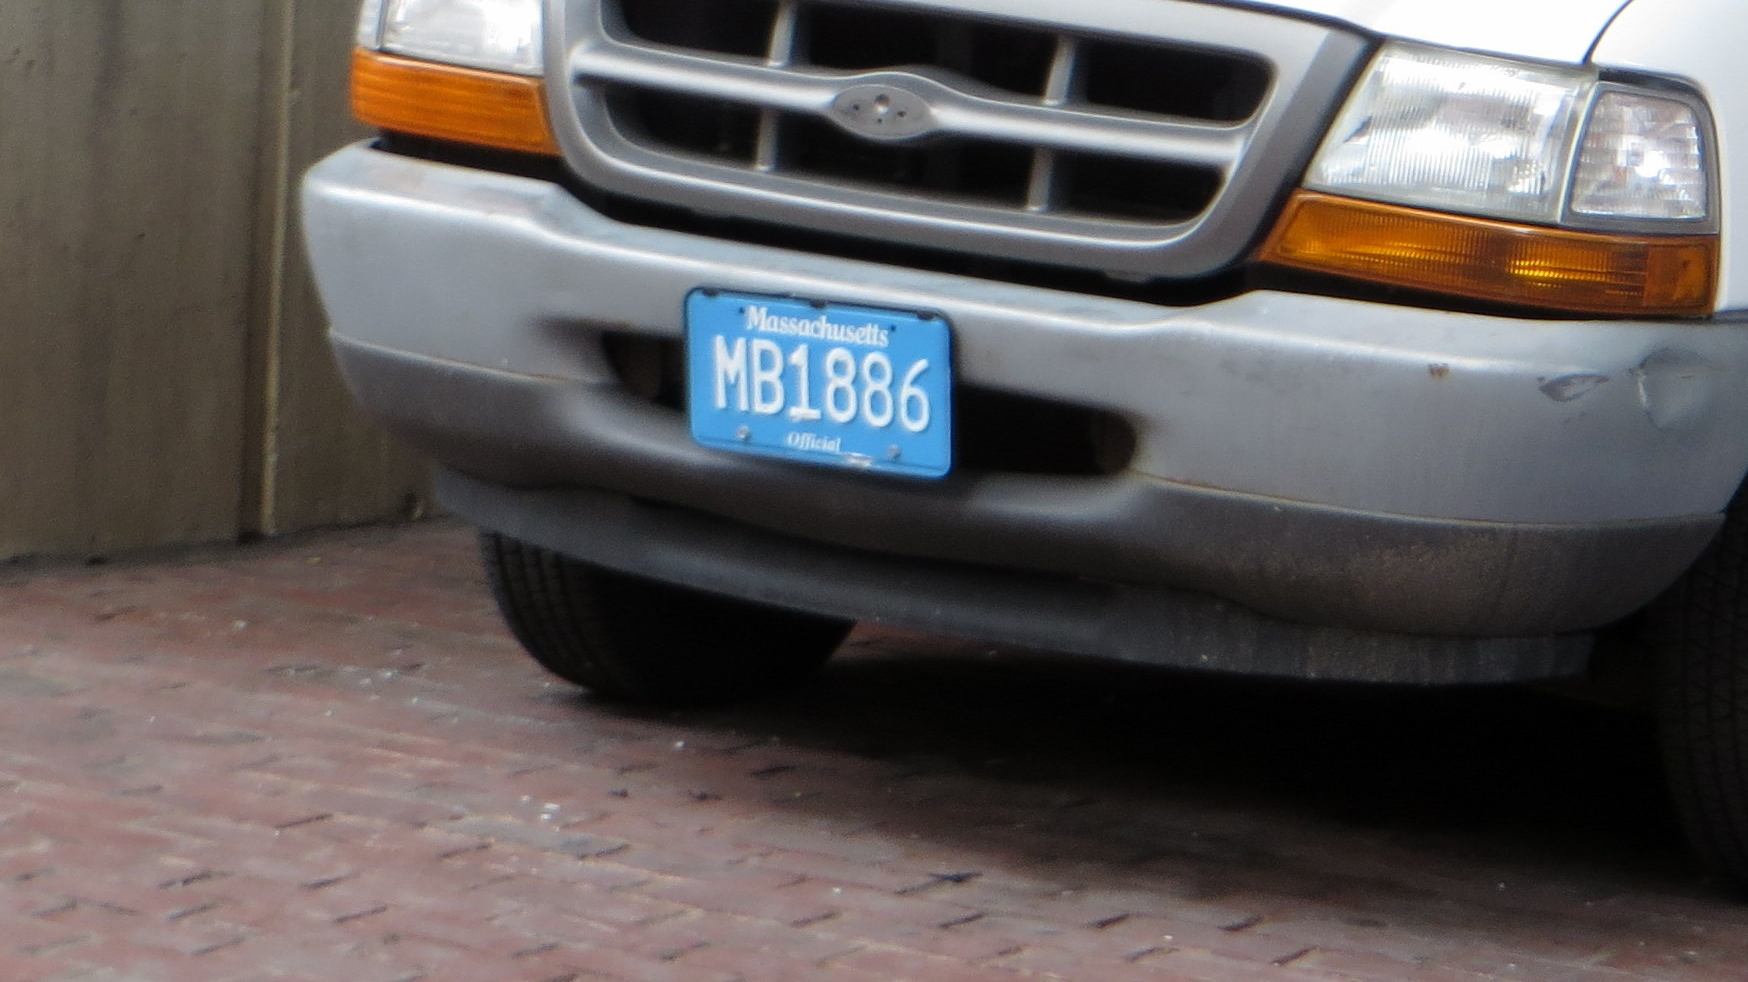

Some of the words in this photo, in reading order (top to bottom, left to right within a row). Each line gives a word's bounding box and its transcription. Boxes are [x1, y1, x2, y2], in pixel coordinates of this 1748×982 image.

[746, 305, 890, 348] Massachusetts
[713, 334, 931, 433] MB1886
[787, 431, 841, 453] Official
